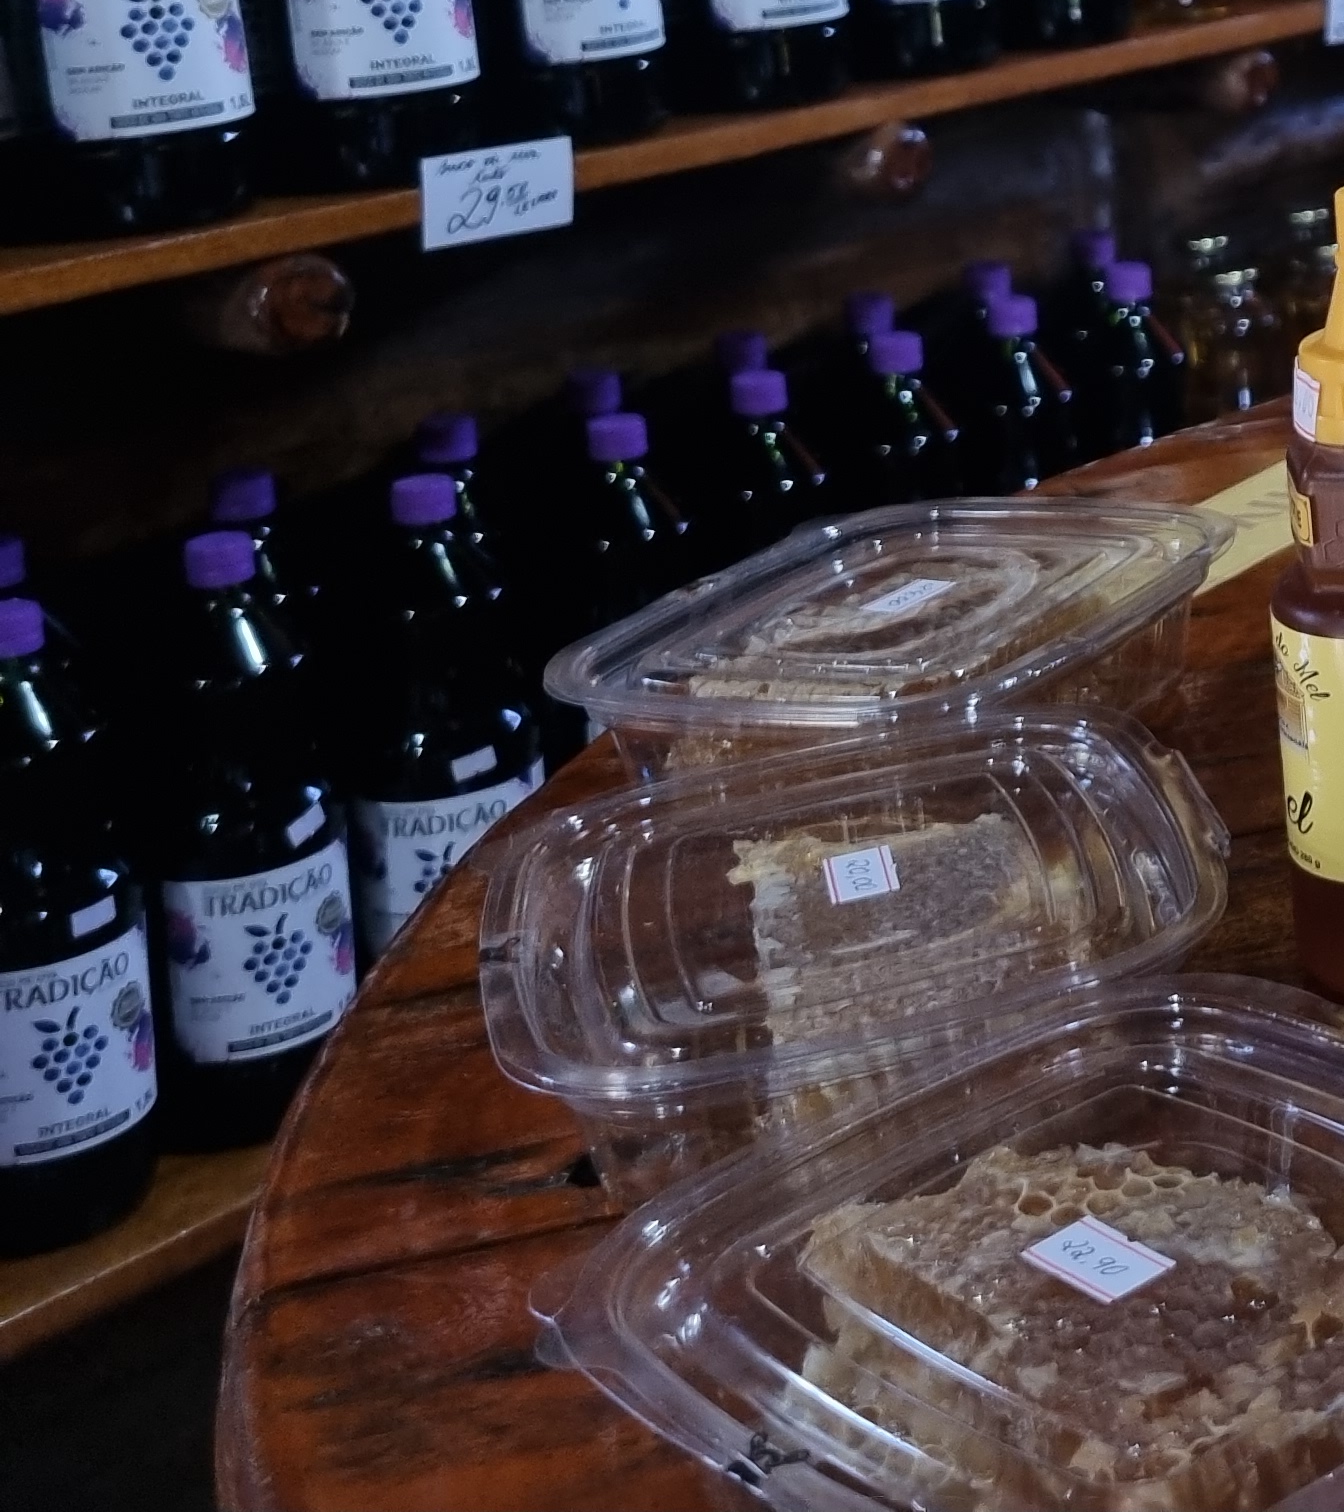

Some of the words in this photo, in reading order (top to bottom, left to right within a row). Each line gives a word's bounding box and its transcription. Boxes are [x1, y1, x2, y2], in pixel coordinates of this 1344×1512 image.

[369, 54, 436, 70] INTEGRAL
[133, 91, 205, 110] INTEGRAL
[1293, 659, 1331, 703] Mel
[383, 798, 508, 838] TRADIÇÃO
[206, 863, 334, 918] TRADIÇÃO
[37, 1106, 112, 1138] INTEGRAL
